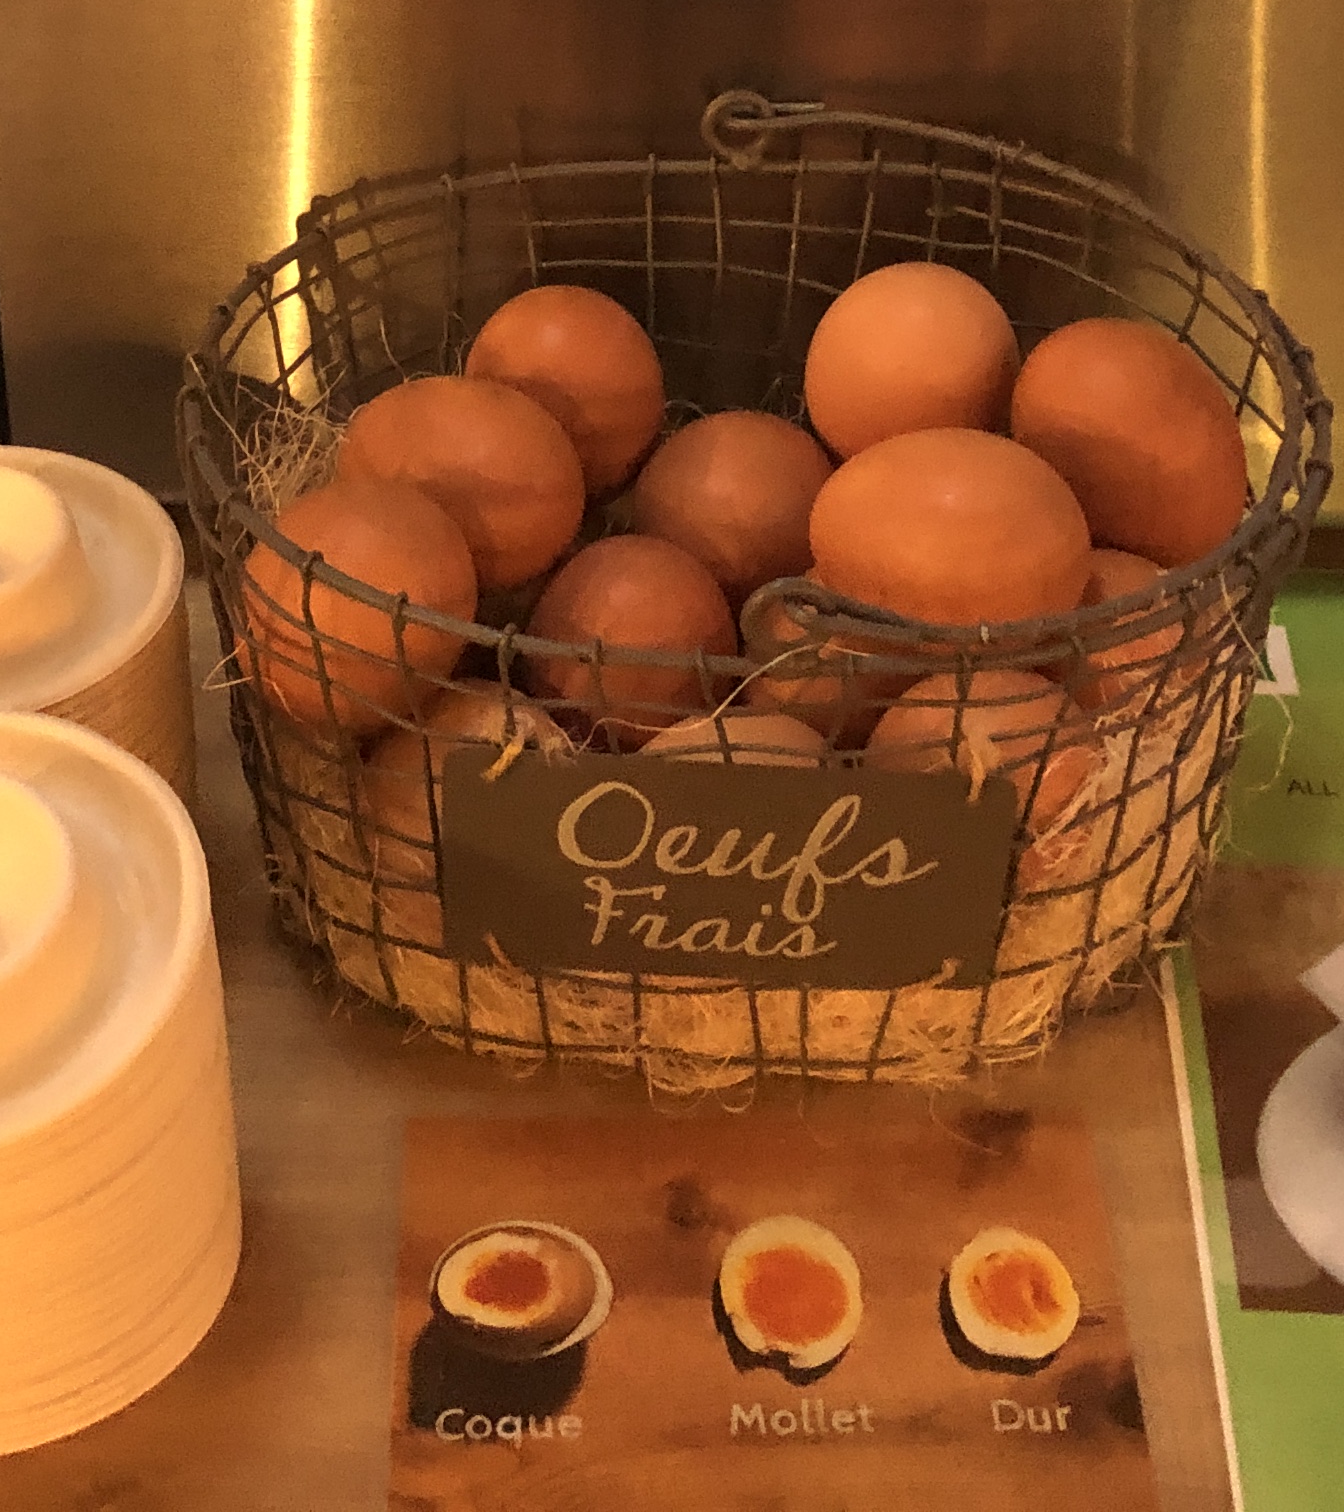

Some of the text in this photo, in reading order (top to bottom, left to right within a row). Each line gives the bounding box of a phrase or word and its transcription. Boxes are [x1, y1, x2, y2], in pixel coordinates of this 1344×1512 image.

[1286, 778, 1338, 799] ALL
[557, 780, 940, 924] Oeufs
[581, 876, 838, 960] Frais
[434, 1407, 584, 1445] Coque
[728, 1398, 877, 1438] Mollet
[990, 1397, 1076, 1435] Dur
